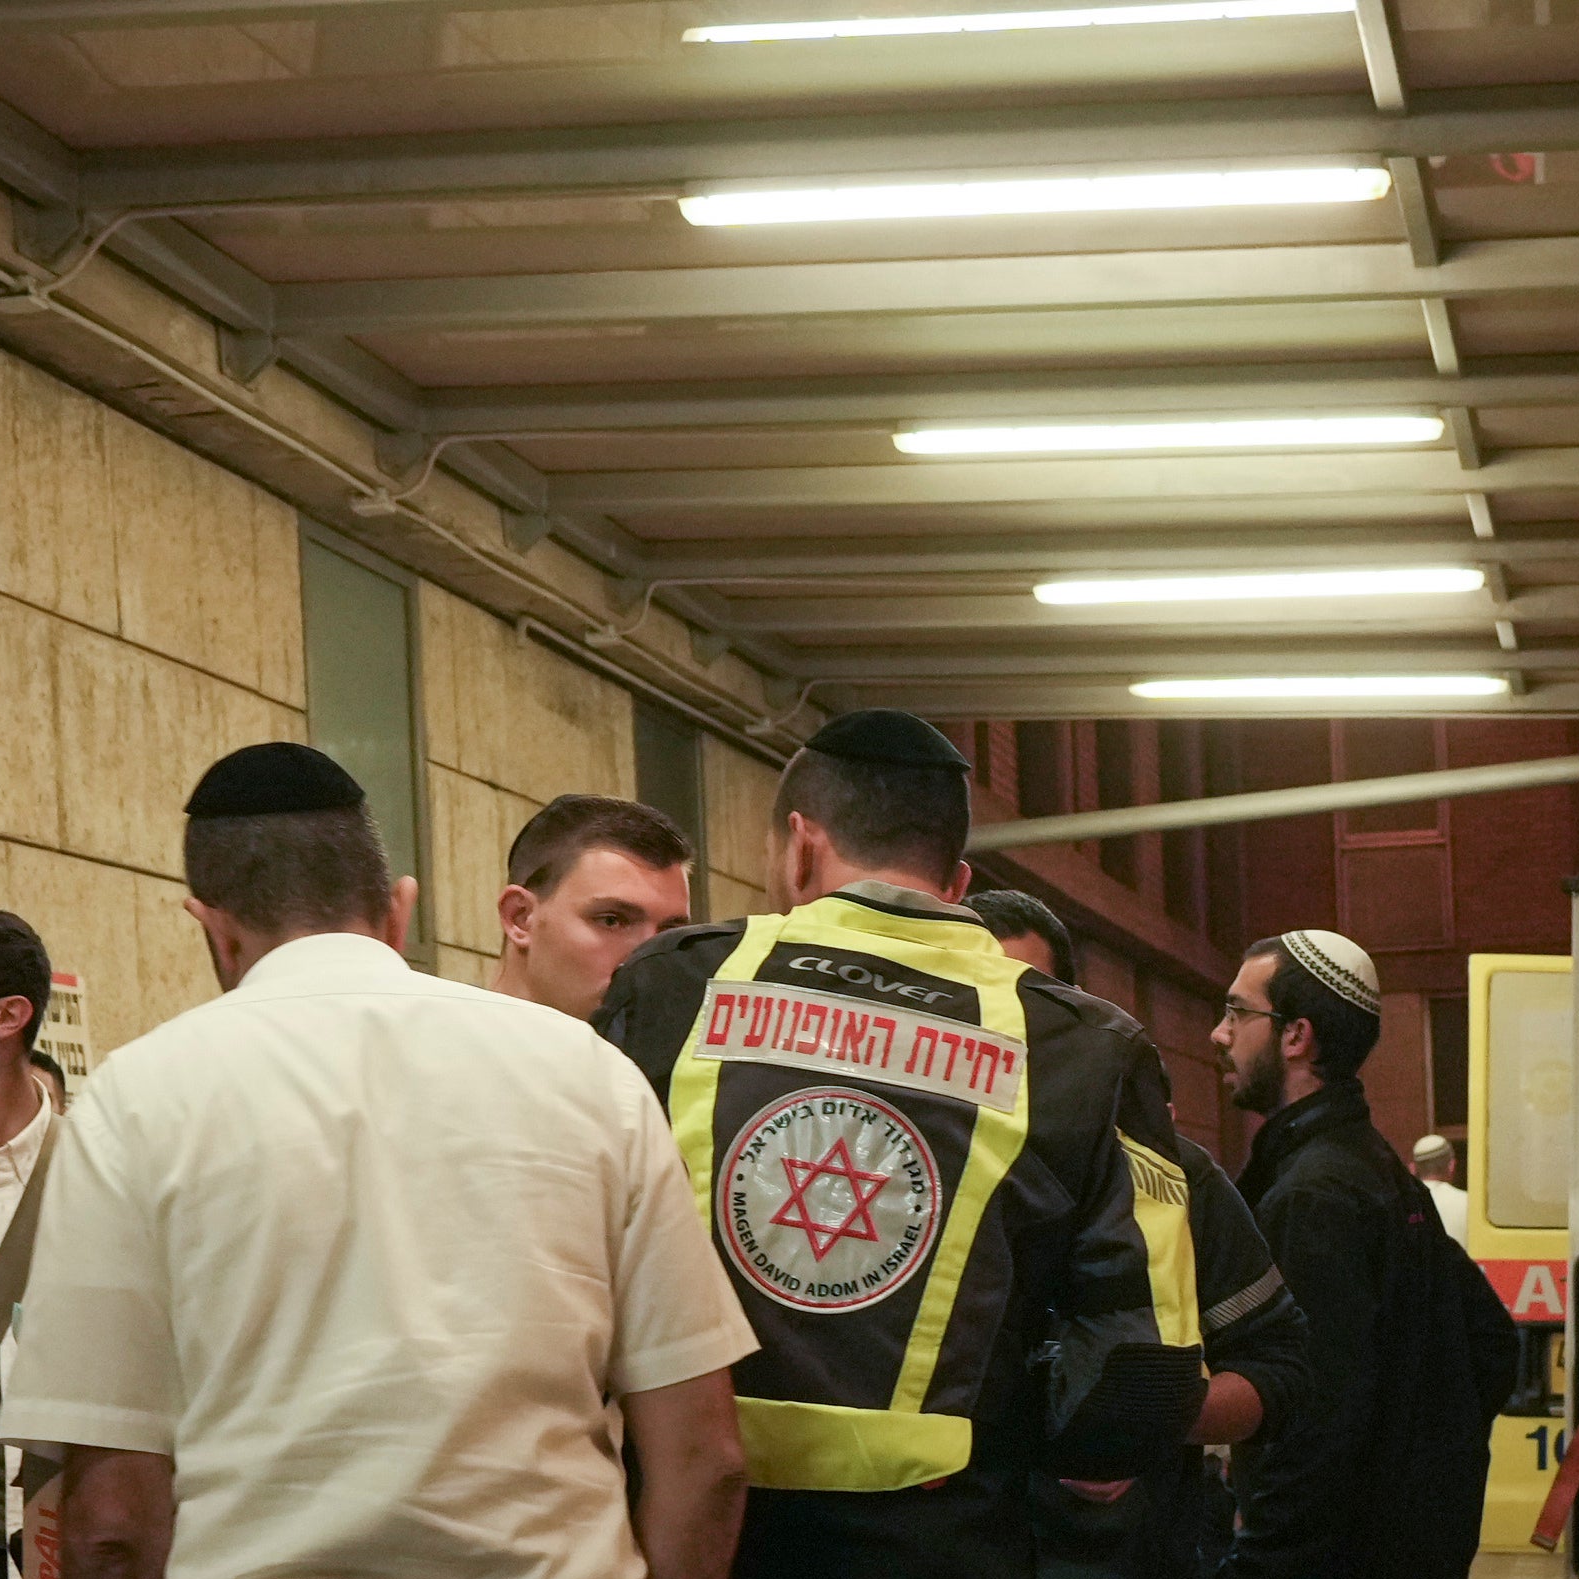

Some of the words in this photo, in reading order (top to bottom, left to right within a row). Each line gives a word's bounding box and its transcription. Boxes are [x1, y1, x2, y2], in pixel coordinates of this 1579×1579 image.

[706, 993, 896, 1068] האופנועים
[904, 1025, 1016, 1094] יחידת
[738, 1105, 814, 1163] בישראל
[822, 1101, 878, 1125] אדום
[884, 1122, 912, 1154] דוד
[733, 1191, 759, 1253] MAGEN
[754, 1253, 800, 1291] DAVID
[805, 1281, 859, 1297] ADOM
[863, 1270, 882, 1288] IN
[880, 1223, 922, 1275] ISRAEL
